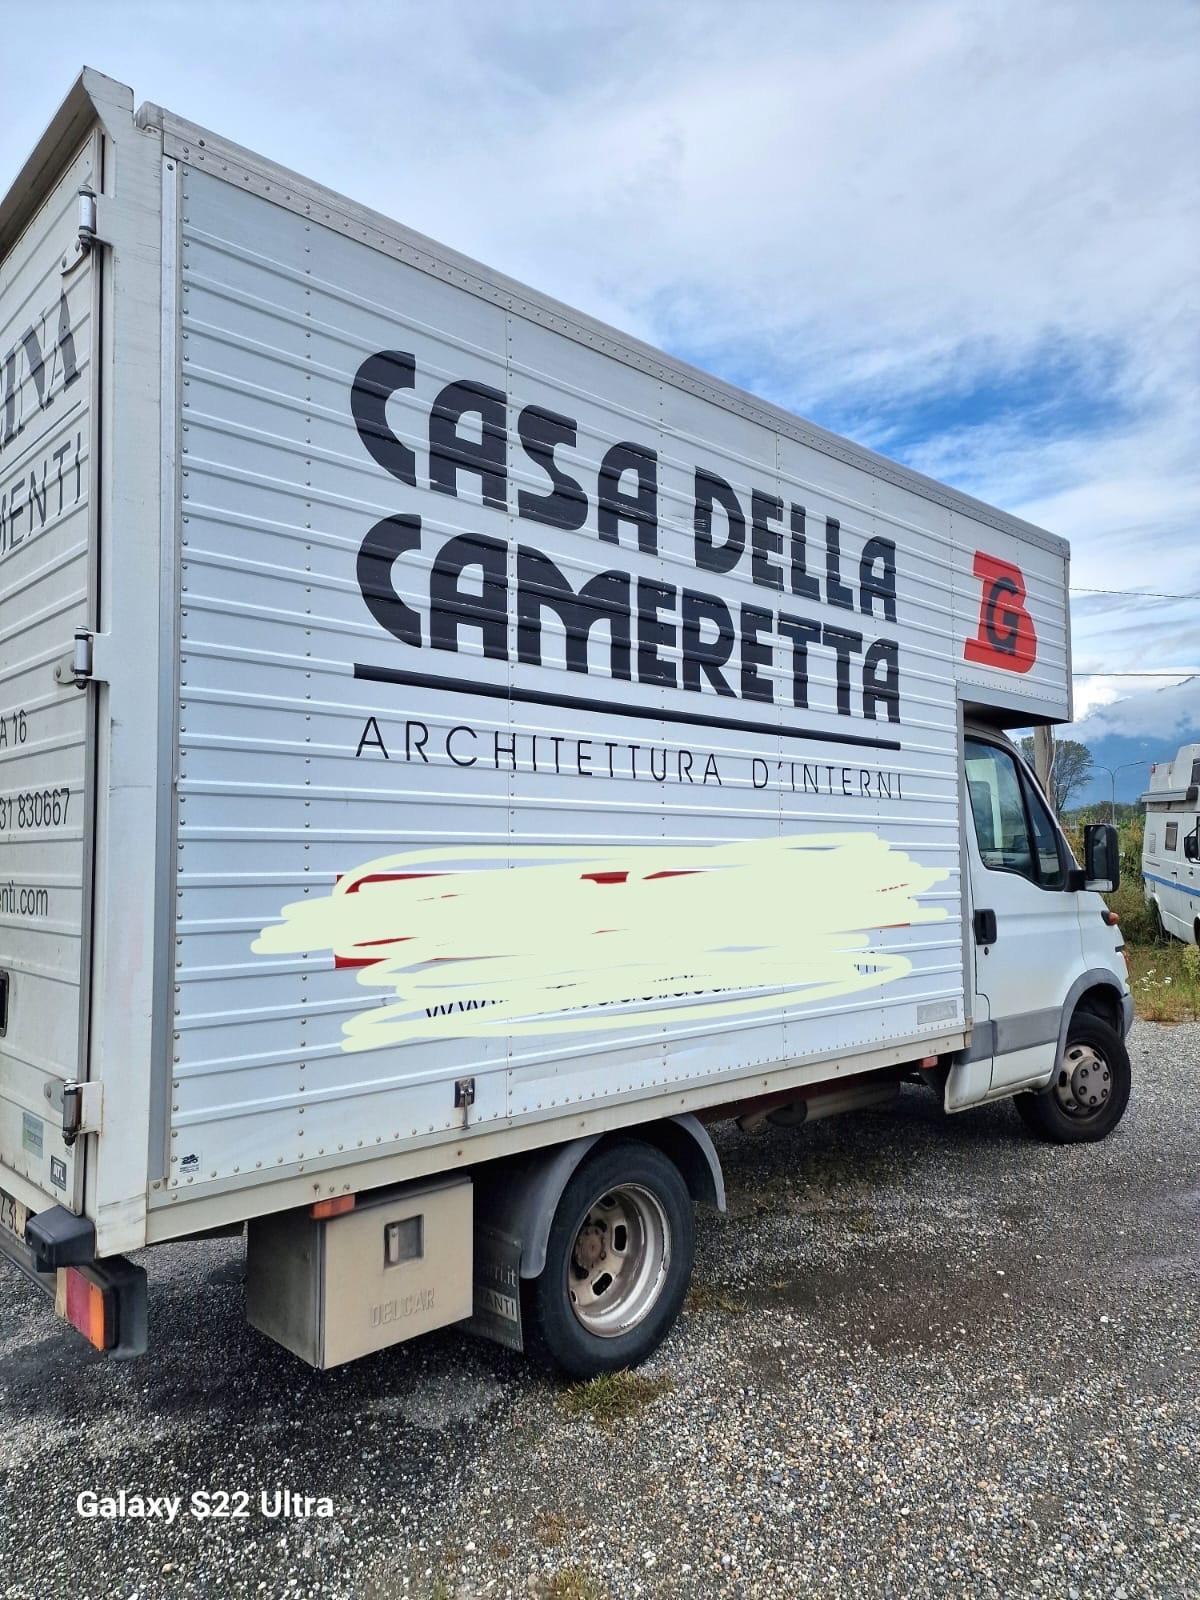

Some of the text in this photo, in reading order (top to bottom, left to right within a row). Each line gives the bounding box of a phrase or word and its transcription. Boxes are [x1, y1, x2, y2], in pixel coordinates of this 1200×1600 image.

[350, 350, 898, 623] CASA DELLA
[356, 513, 901, 724] CAMERETTA
[13, 708, 27, 745] 16
[355, 715, 903, 800] ARCHITETTURA D'INTERNI
[18, 787, 70, 829] 830667
[0, 879, 49, 916] nti.com
[370, 1287, 435, 1329] DELCAR
